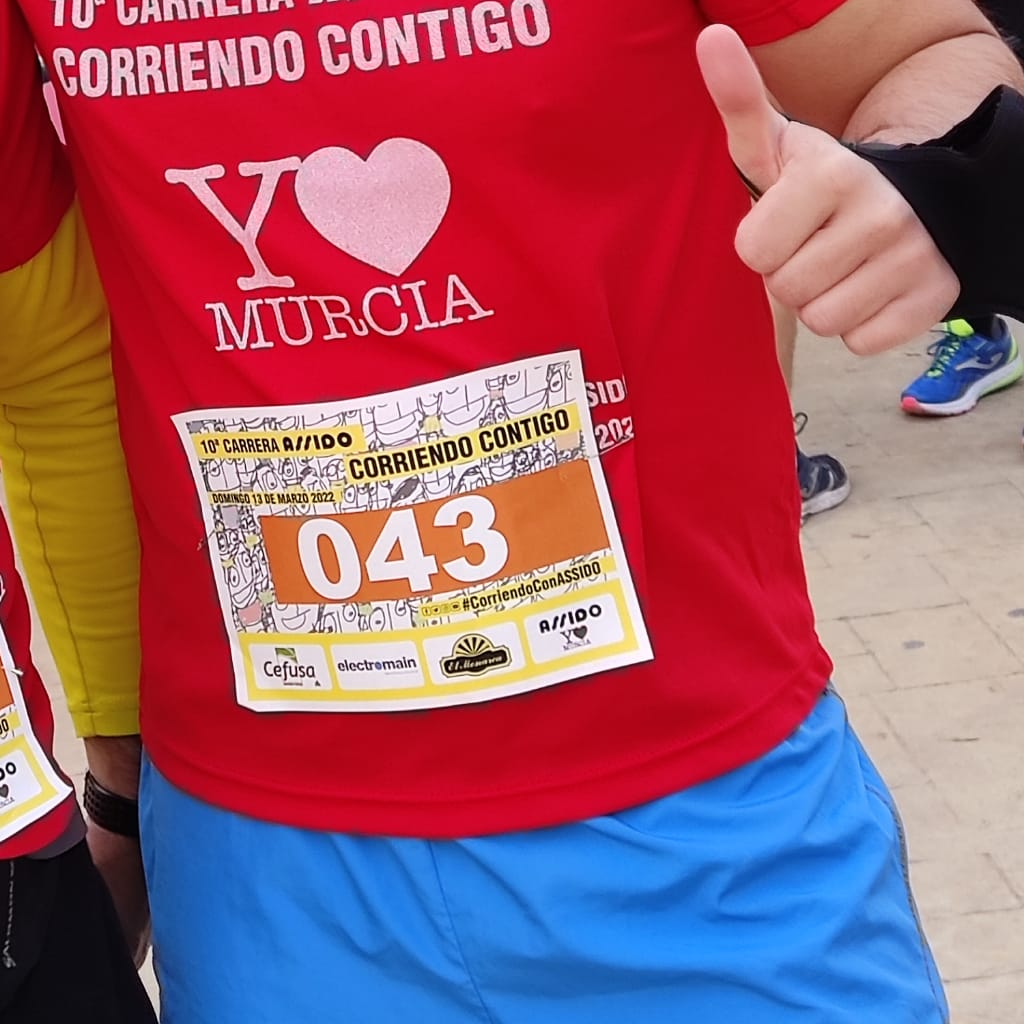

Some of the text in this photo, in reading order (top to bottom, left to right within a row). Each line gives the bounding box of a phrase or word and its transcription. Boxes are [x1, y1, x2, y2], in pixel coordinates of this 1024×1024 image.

[52, 29, 306, 99] CORRIENDO
[165, 155, 303, 291] Y
[204, 274, 495, 352] MURCIA
[585, 374, 628, 408] SID
[224, 437, 280, 454] CARRERA
[282, 431, 353, 451] ASSIDO
[348, 408, 570, 480] CORRIENDO CONTIGO
[212, 491, 336, 505] DOMINGO 13 DE MARZO 2022
[296, 493, 510, 601] 043
[462, 561, 602, 612] #CorriendoConASSIDO
[539, 604, 602, 634] ASSIDO
[263, 660, 316, 681] Cefusa
[337, 656, 418, 673] electromain
